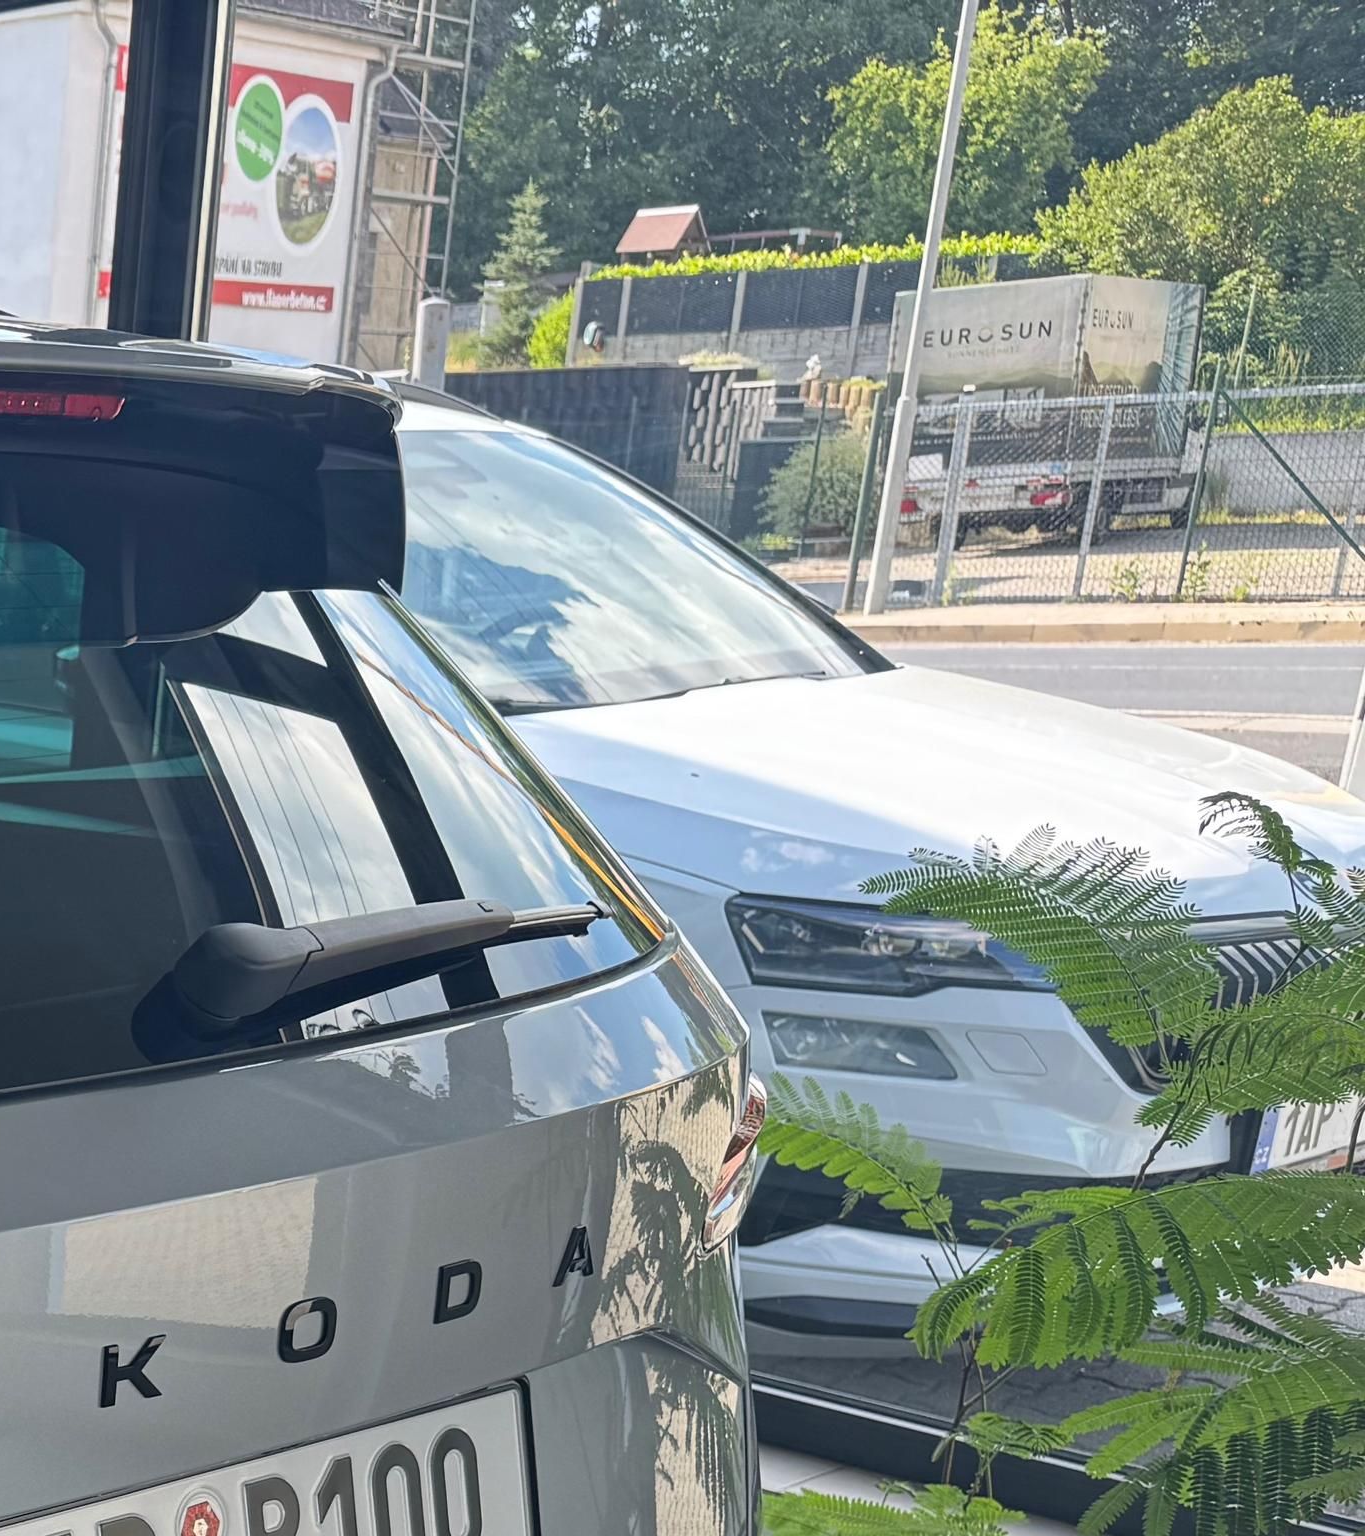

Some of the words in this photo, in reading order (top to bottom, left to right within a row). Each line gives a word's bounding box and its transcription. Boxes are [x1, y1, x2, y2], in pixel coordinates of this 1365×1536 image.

[1093, 308, 1134, 330] EUROSUN
[923, 320, 1053, 348] EUROSUN
[1284, 1103, 1335, 1157] 1AP
